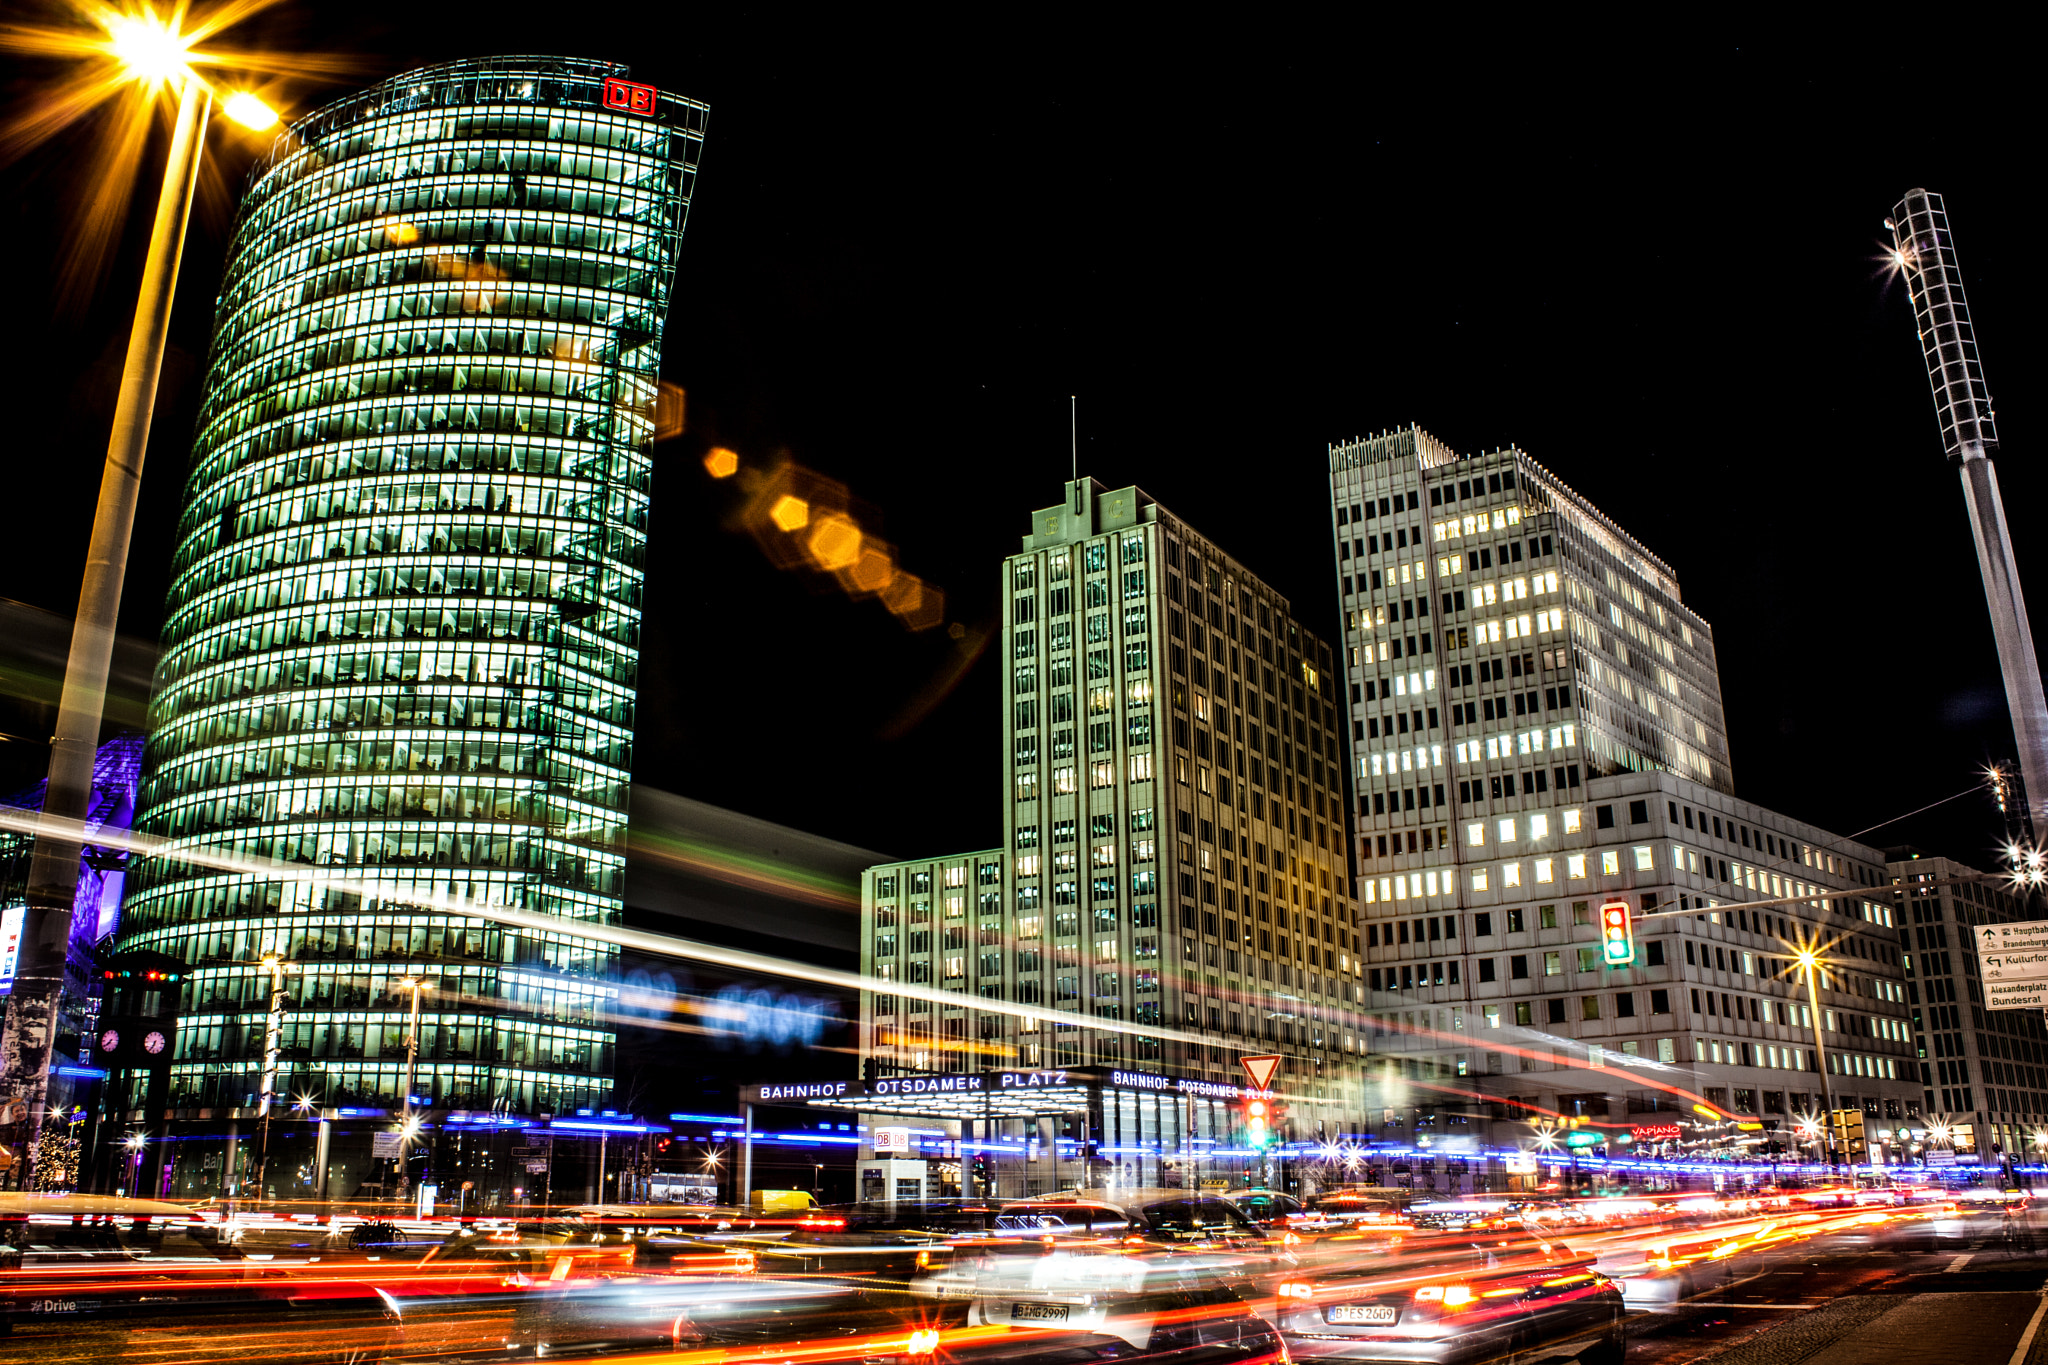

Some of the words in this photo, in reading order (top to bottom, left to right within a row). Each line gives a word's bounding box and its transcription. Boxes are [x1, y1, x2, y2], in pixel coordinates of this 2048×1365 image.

[608, 82, 651, 111] DB
[1991, 983, 2047, 994] Alexanderplatz
[1992, 995, 2042, 1006] Bundesrat
[760, 1083, 847, 1099] BAHNHOF
[864, 1077, 981, 1094] OTSDAMER
[1002, 1071, 1067, 1087] PLATZ
[1113, 1071, 1170, 1090] BAHNHOF
[1178, 1080, 1238, 1099] POTSDAMER
[1632, 1125, 1681, 1136] VAPIANO
[877, 1134, 890, 1145] DB
[894, 1134, 906, 1145] DB
[1042, 1307, 1066, 1319] 2999
[1365, 1307, 1393, 1320] 2609
